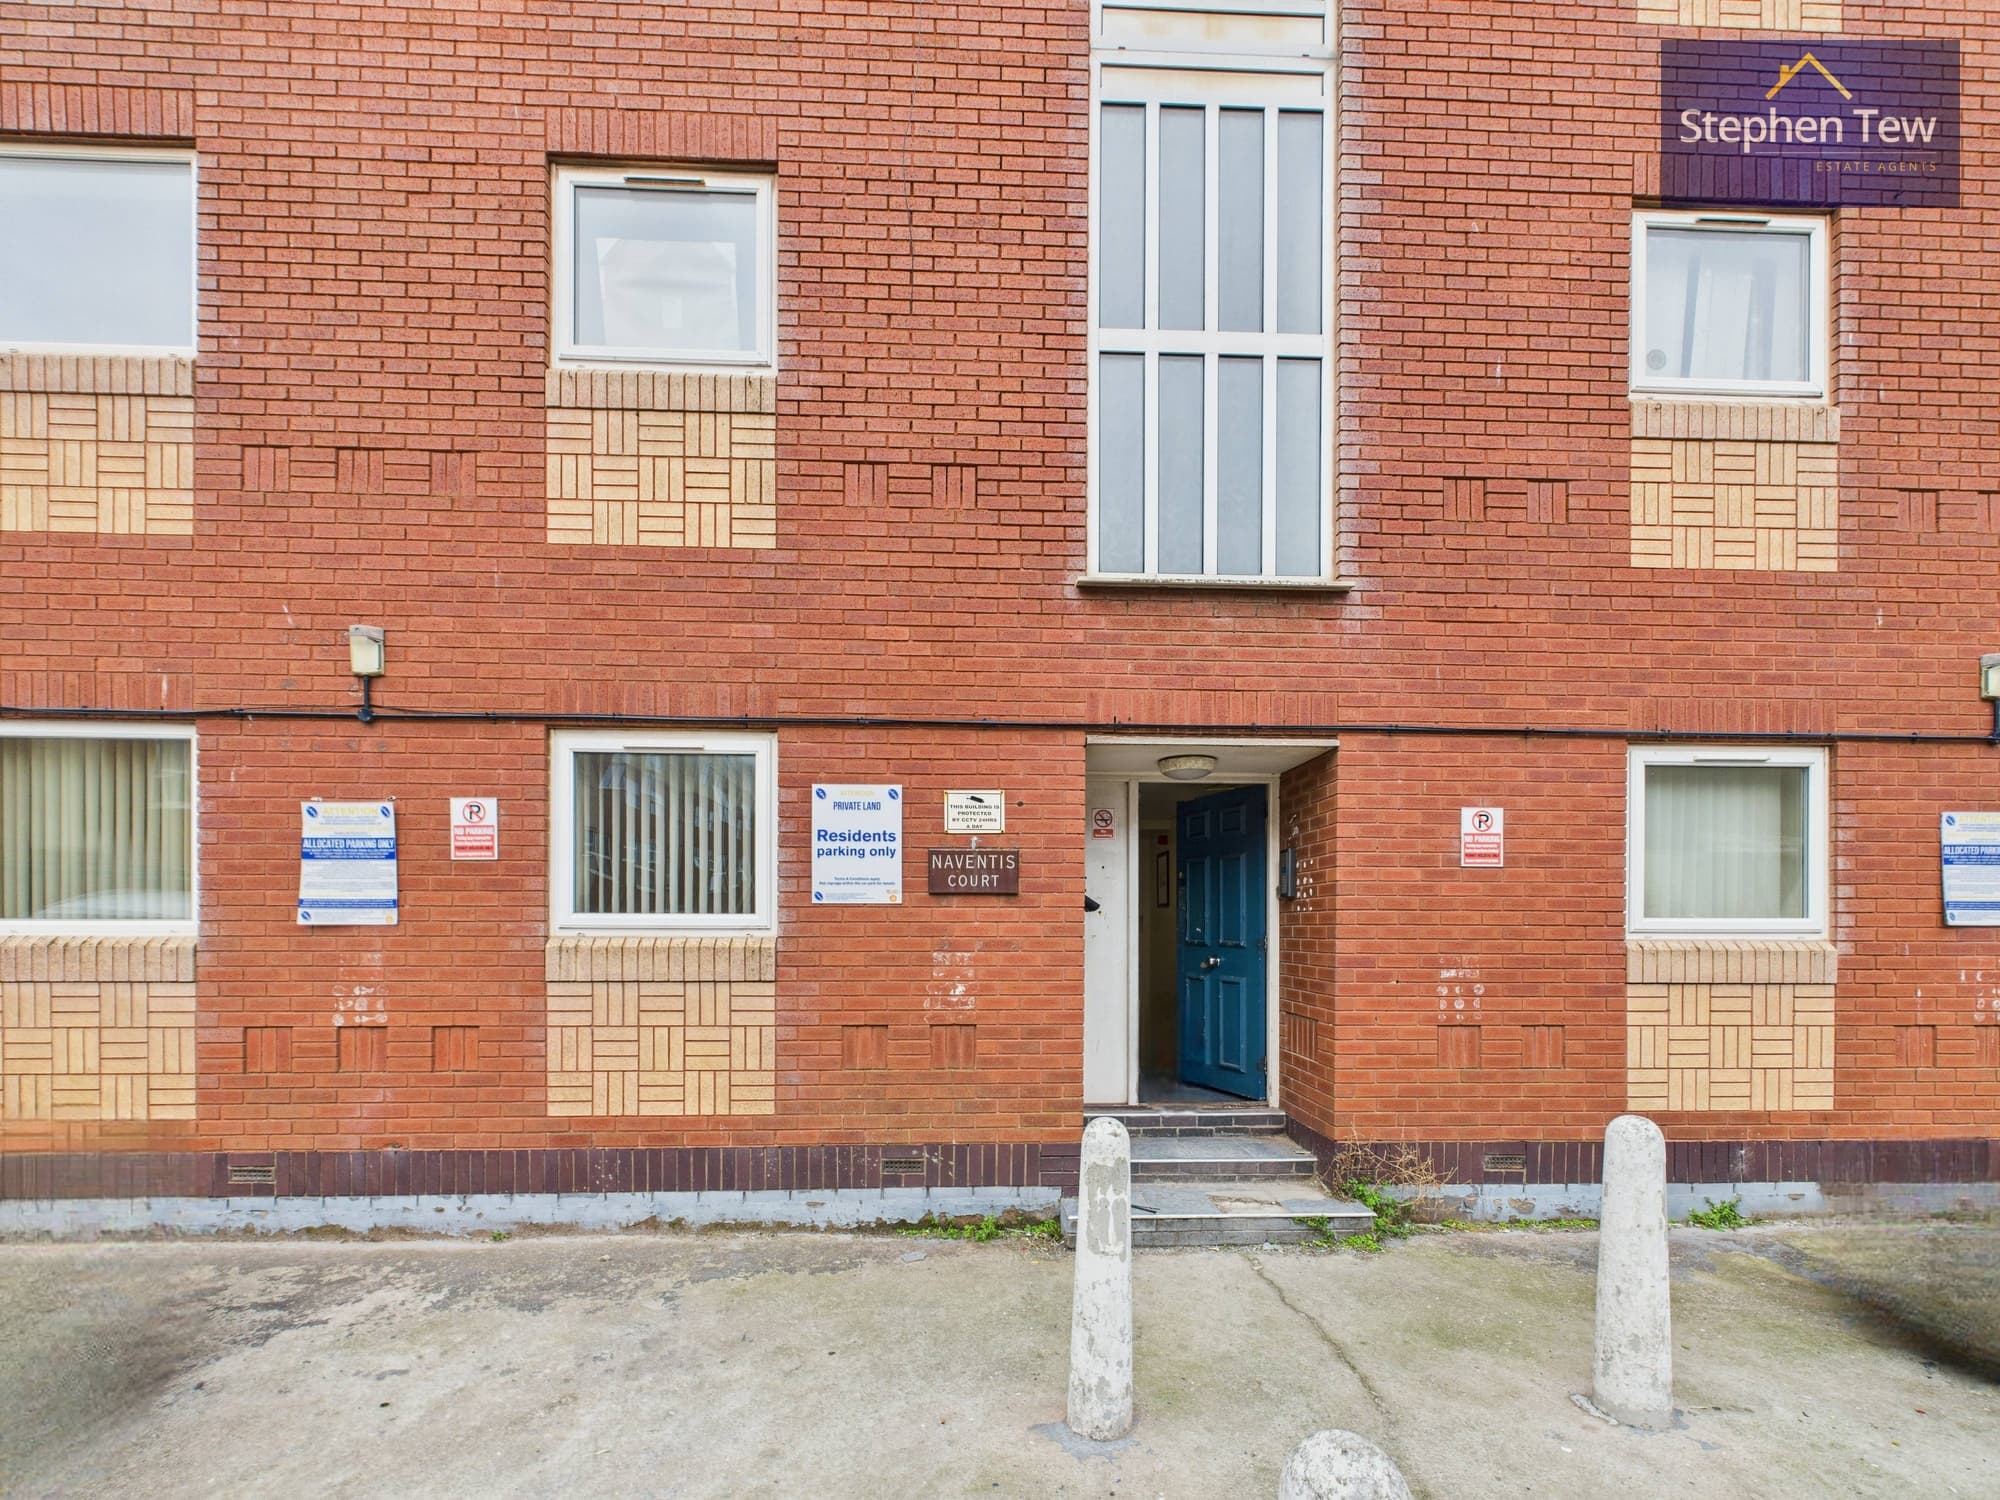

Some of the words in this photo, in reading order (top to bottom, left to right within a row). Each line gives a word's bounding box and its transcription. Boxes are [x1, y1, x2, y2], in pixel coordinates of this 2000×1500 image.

[833, 801, 861, 811] PRIVATE
[862, 801, 881, 811] LAND
[816, 829, 897, 842] Residents
[303, 838, 345, 849] ALLOCATED
[345, 838, 377, 849] PARKING
[377, 838, 394, 849] ONLY
[816, 846, 866, 859] parking
[869, 846, 896, 859] only
[1943, 846, 1981, 856] ALLOCATED
[932, 854, 1016, 870] NAVENTIS
[947, 874, 1000, 888] COURT
